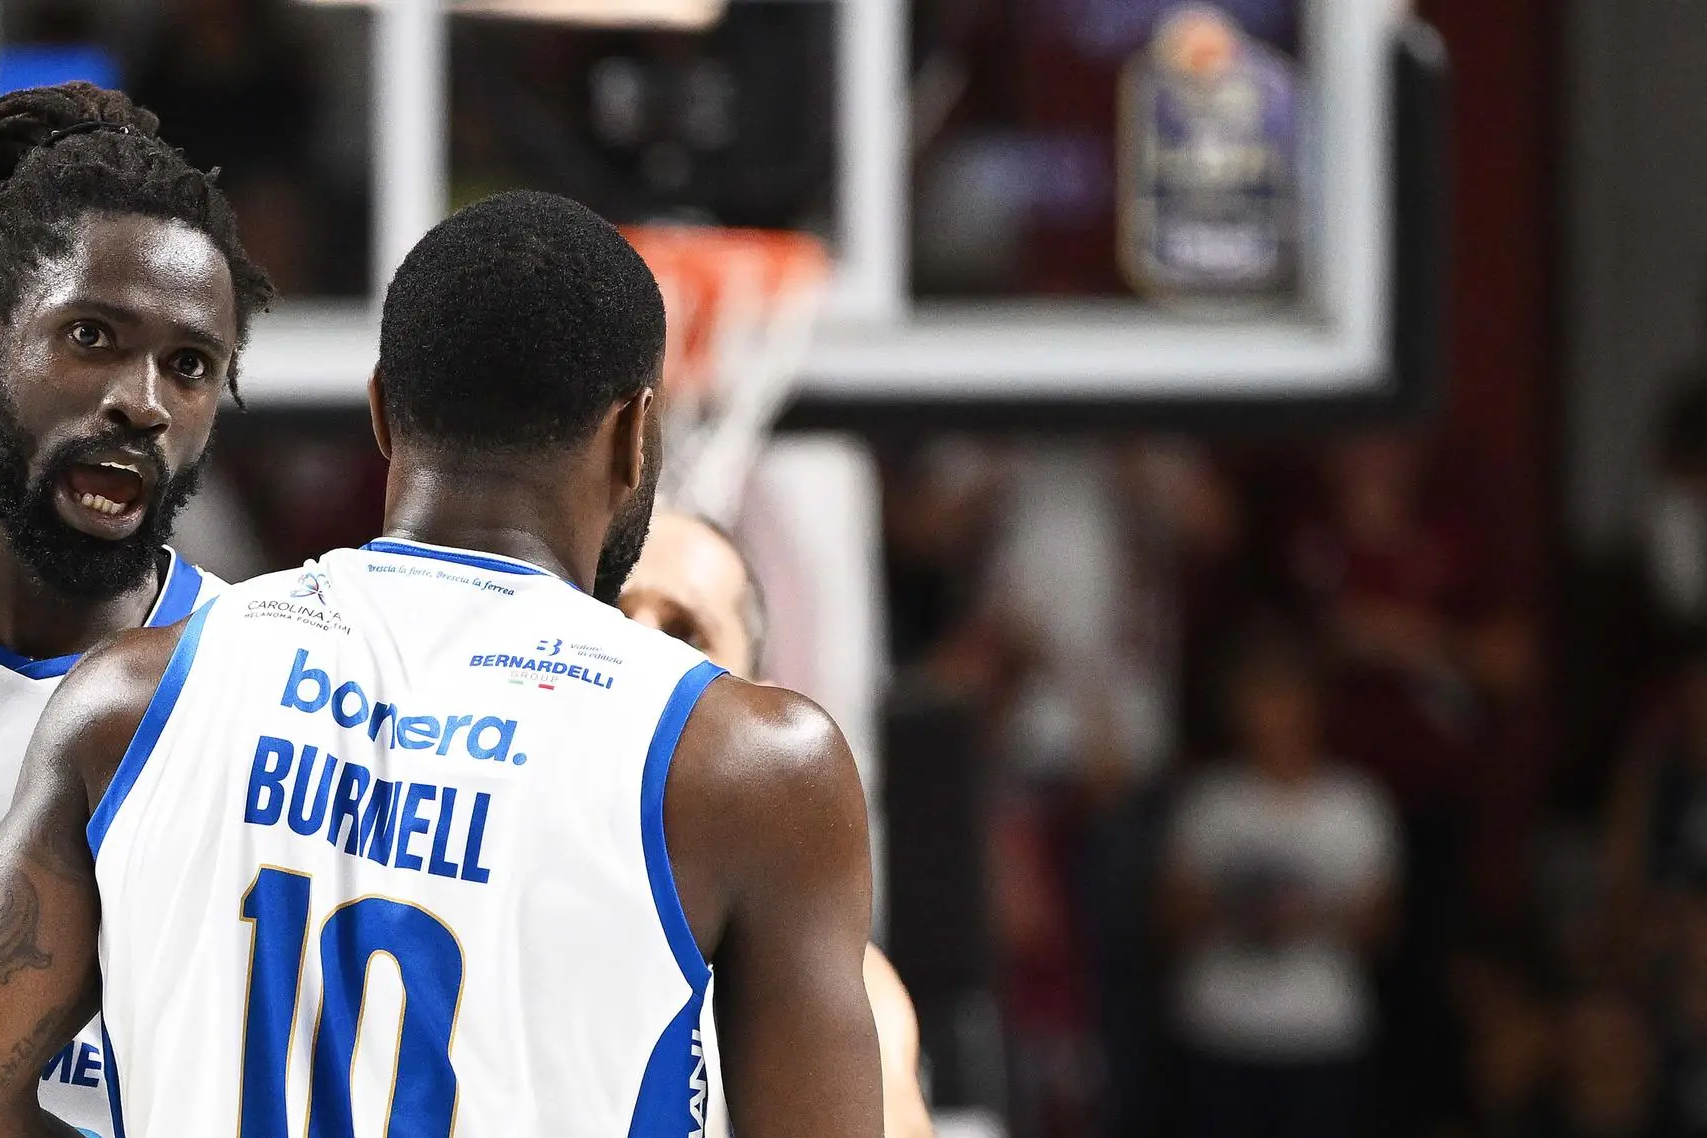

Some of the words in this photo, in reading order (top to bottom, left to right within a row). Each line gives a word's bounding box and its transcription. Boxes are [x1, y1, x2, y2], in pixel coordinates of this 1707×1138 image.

[482, 580, 515, 597] ferrea
[247, 599, 324, 622] CAROLINA
[469, 653, 615, 690] BERNARDELLI
[279, 647, 528, 766] bonera.
[243, 734, 492, 885] BURNELL
